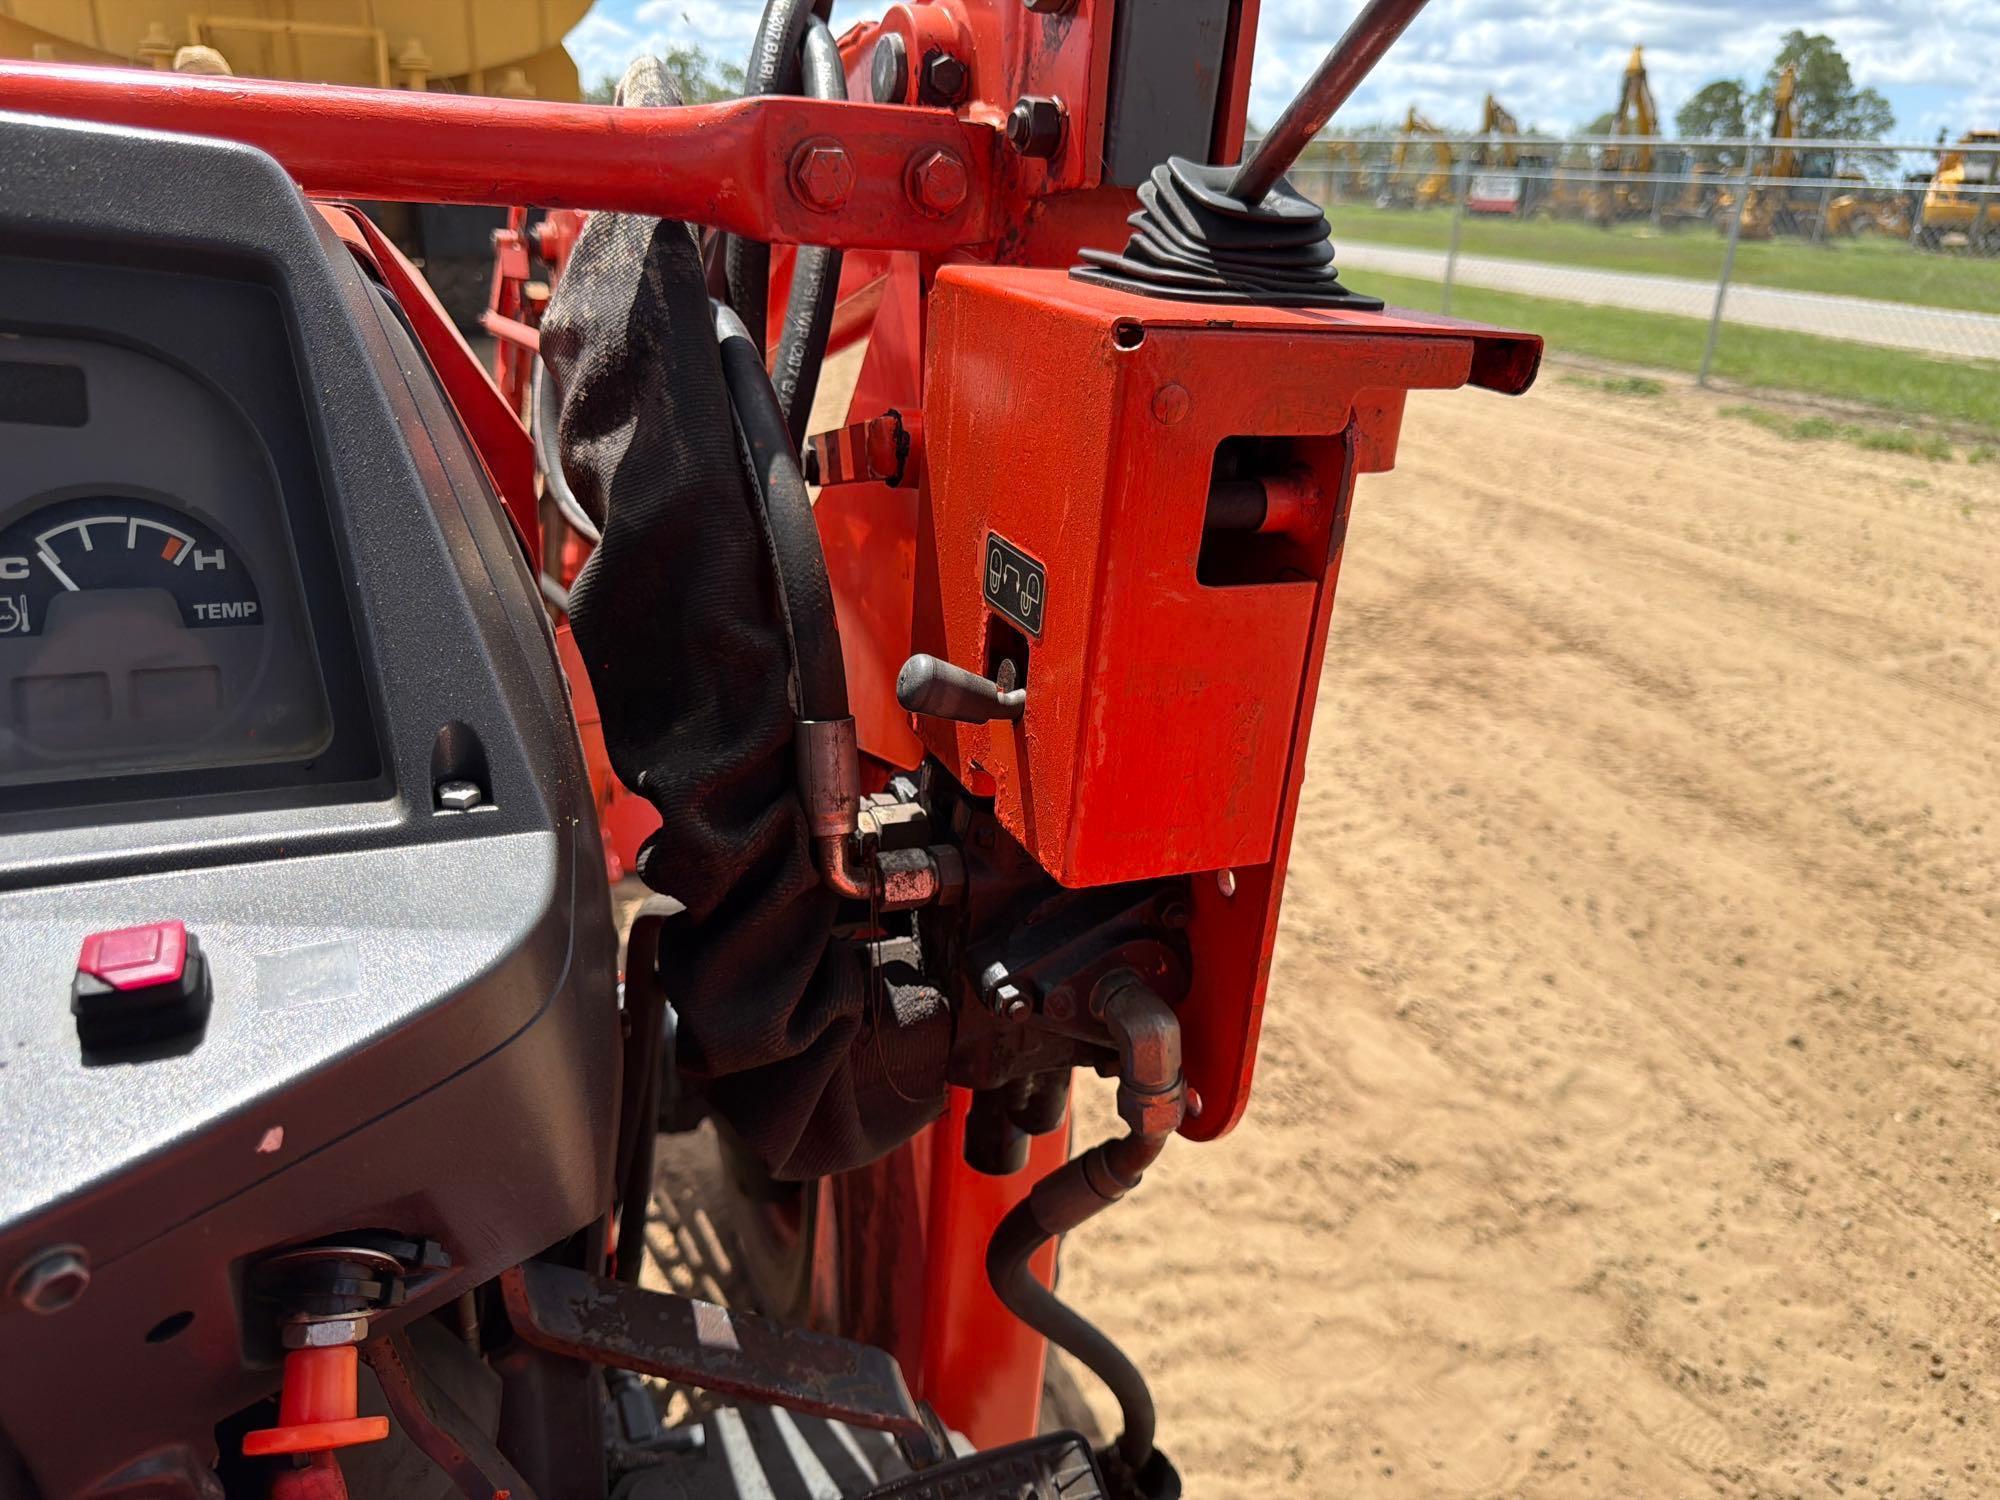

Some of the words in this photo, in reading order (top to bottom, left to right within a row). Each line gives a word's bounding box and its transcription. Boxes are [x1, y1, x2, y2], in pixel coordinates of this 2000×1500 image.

[0, 557, 30, 579] C
[194, 549, 226, 570] H
[193, 601, 258, 620] TEMP
